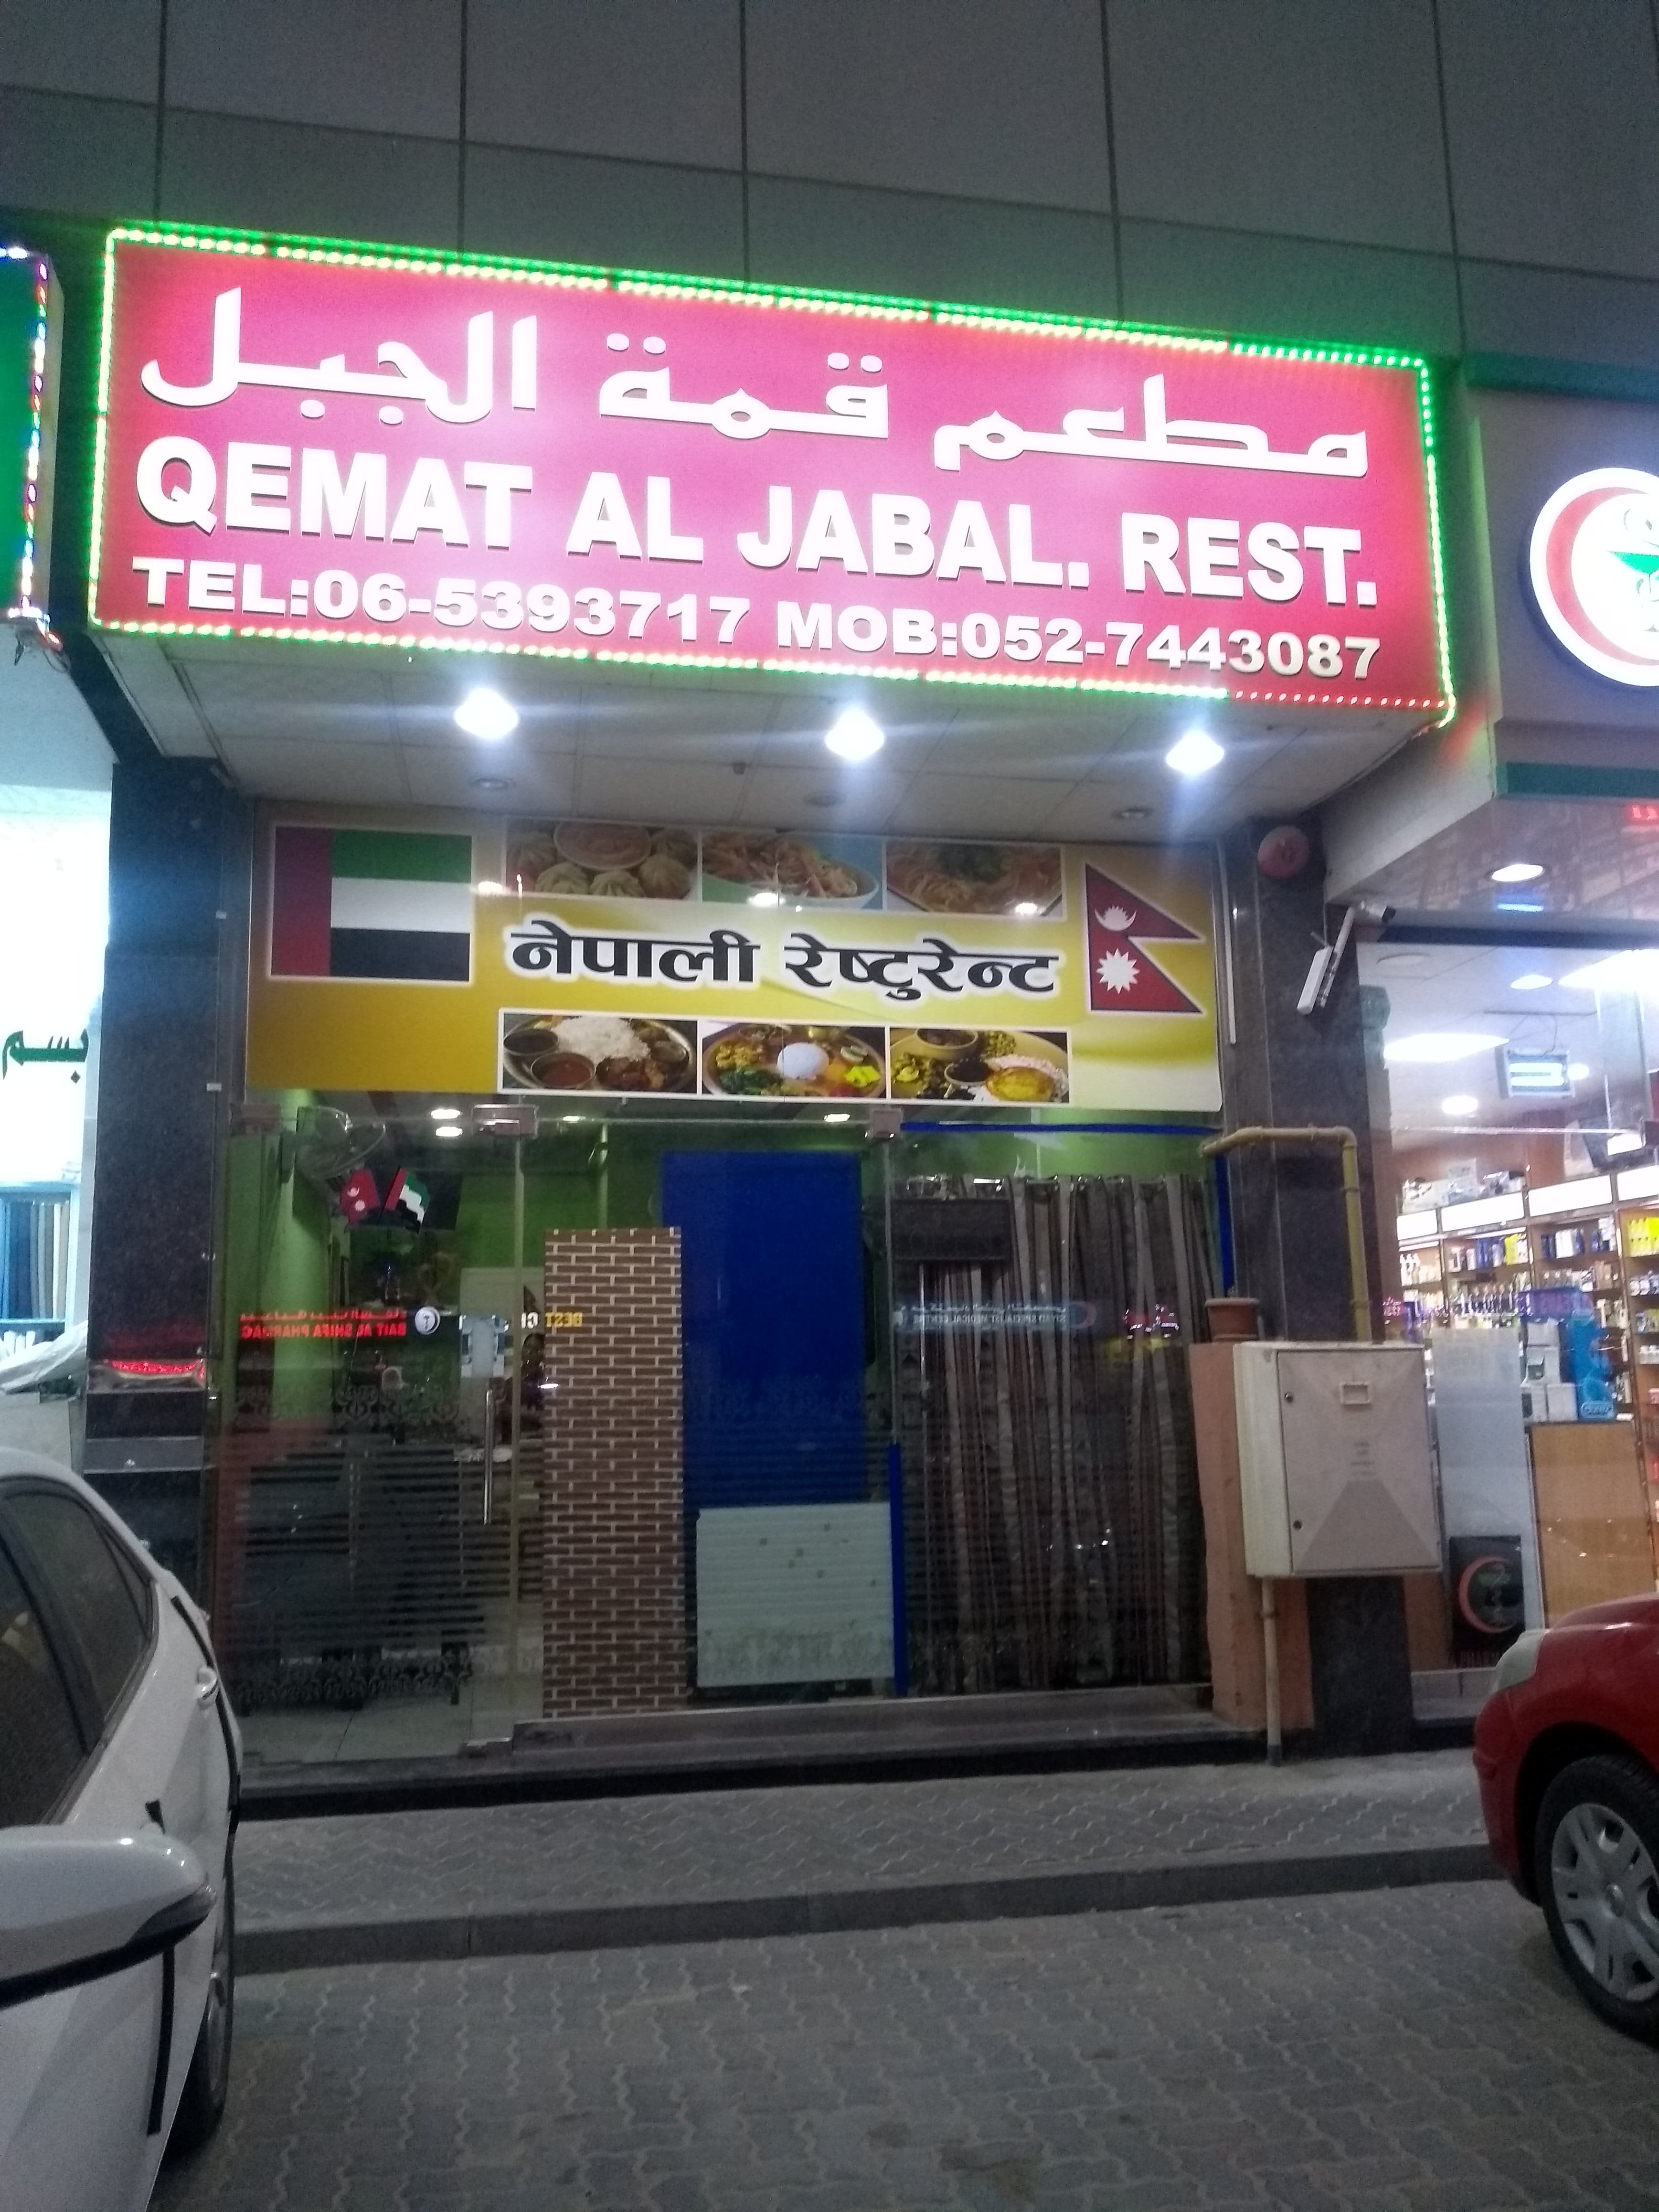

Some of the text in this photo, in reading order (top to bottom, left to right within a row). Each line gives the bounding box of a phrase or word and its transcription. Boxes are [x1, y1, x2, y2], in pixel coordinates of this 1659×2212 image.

[140, 287, 1368, 478] مطعم قمة الجبل
[136, 435, 1378, 607] QEMAT AL JABAL. REST.
[132, 557, 1381, 679] TEL:06-5393717 MOB:052-7443087
[510, 920, 1059, 1000] नेपाली रेष्टुरेन्ट
